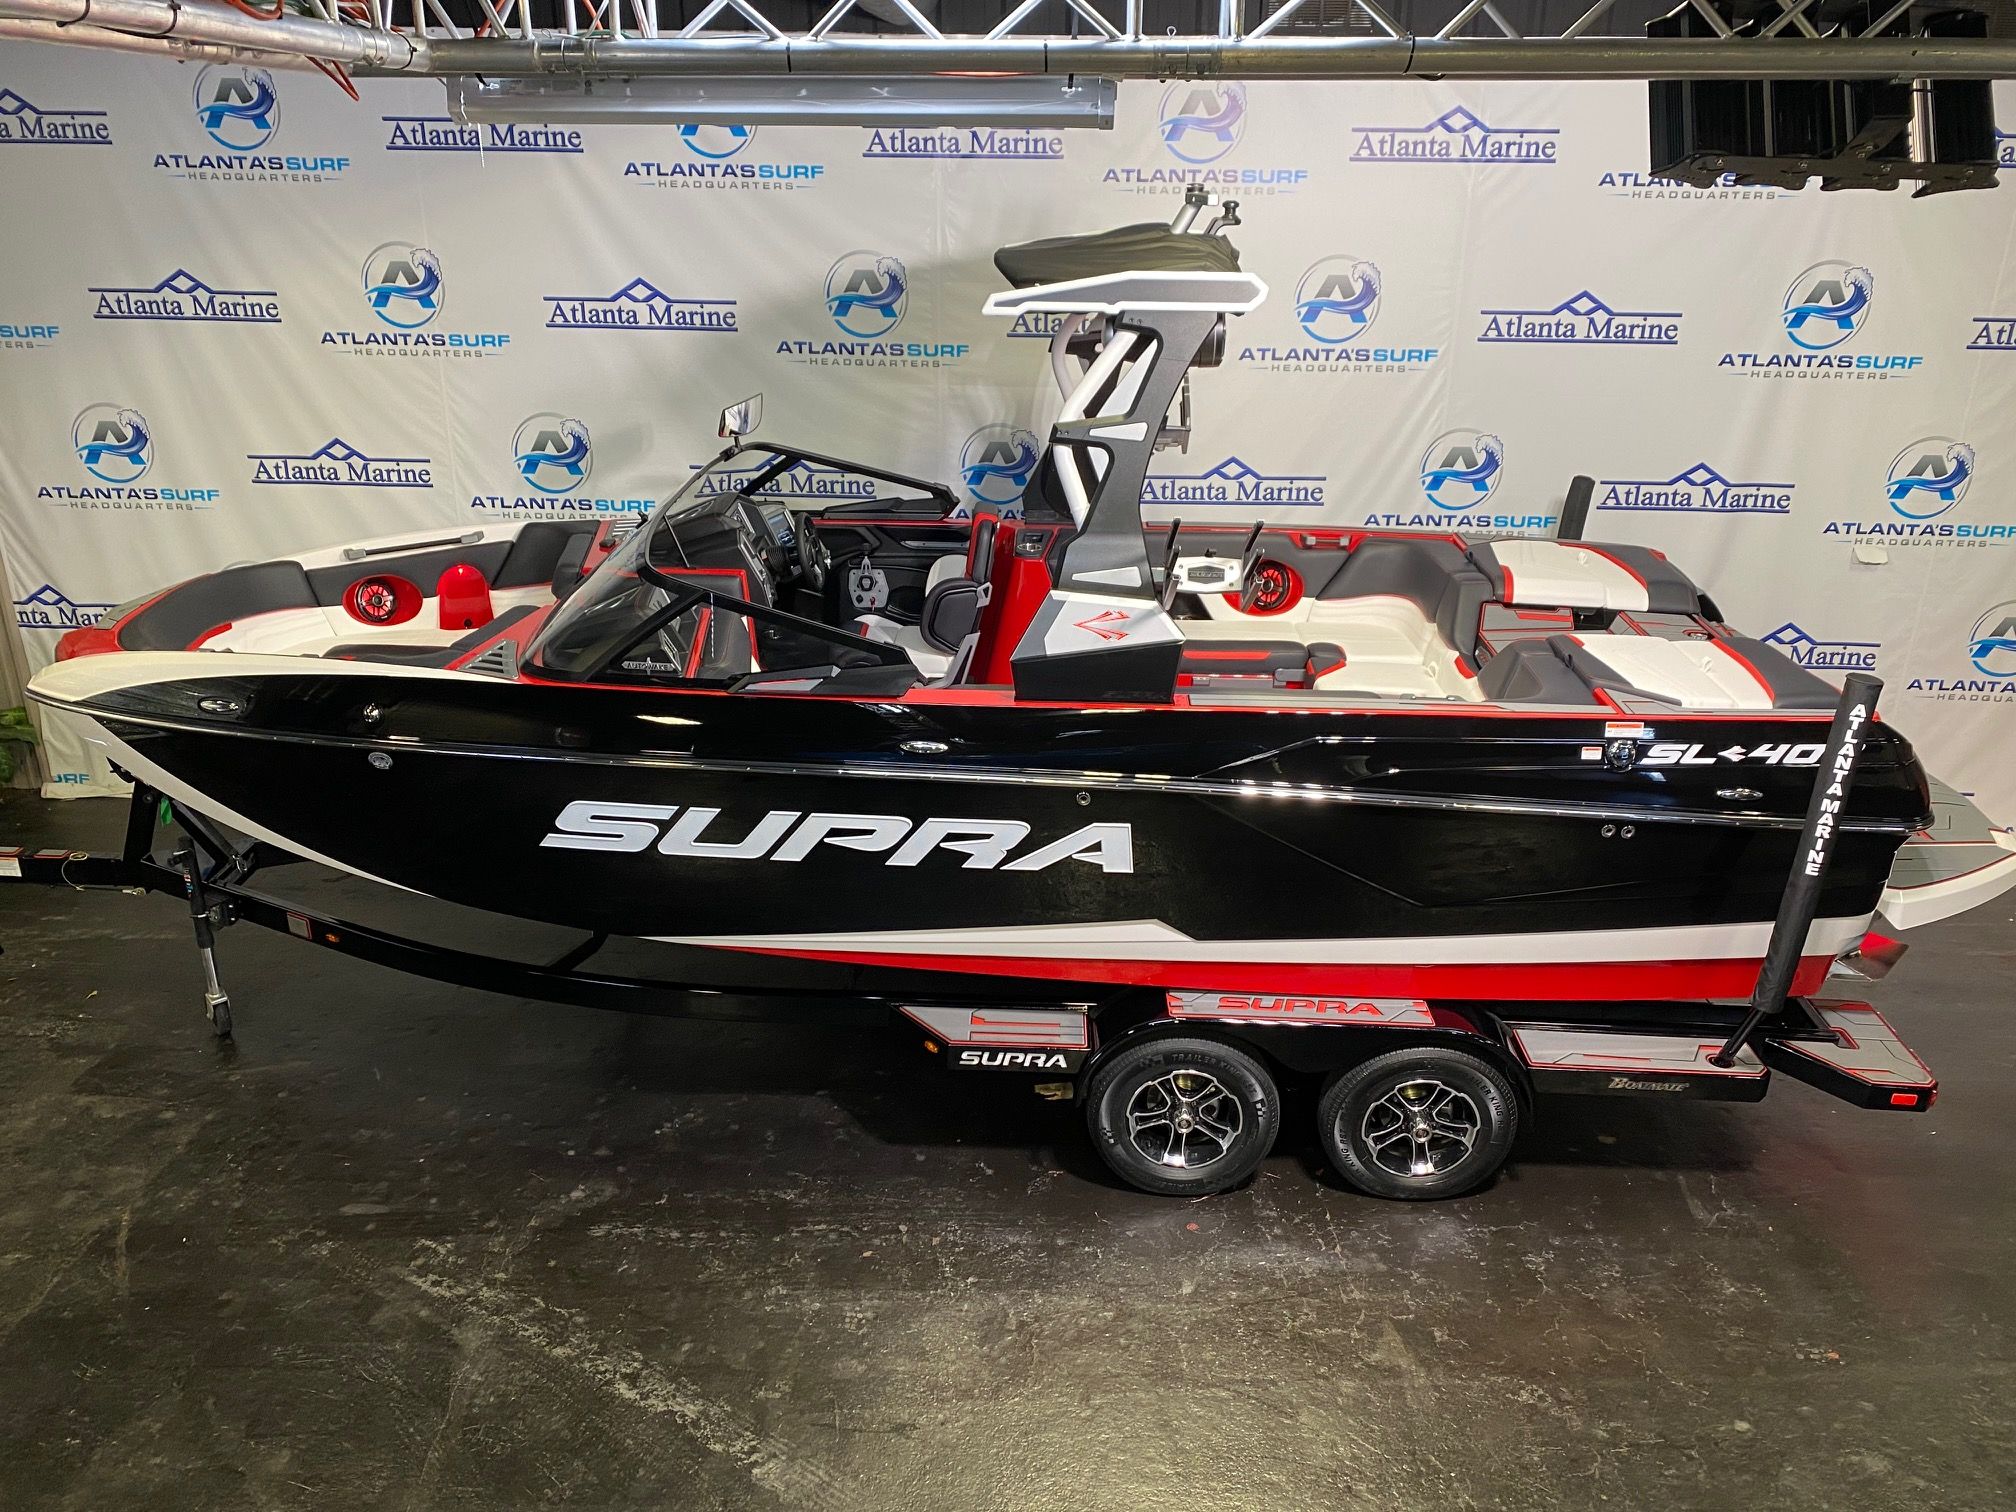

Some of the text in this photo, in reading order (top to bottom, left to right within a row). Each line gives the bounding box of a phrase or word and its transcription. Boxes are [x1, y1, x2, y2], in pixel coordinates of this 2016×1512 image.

[19, 114, 109, 140] Marine
[389, 121, 582, 149] Atlanta Marine
[866, 129, 1063, 155] Atlanta Marine
[1355, 132, 1556, 160] Atlanta Marine
[286, 156, 351, 172] SURF
[188, 171, 323, 183] HEADQUARTERS
[757, 164, 825, 180] SURF
[1241, 170, 1309, 184] SURF
[658, 180, 794, 190] HEADQUARTERS
[1136, 185, 1277, 196] HEADARTERS
[1631, 190, 1777, 201] HEADQUARTERS
[95, 292, 279, 319] Atlanta Marine
[549, 301, 736, 328] Atlanta Marine
[0, 325, 60, 338] SURF
[1481, 314, 1679, 341] Atlanta Marine
[447, 333, 511, 348] SURF
[353, 348, 484, 358] HEADQUARTERS
[906, 344, 970, 358] SURF
[1372, 348, 1439, 363] SURF
[808, 357, 941, 369] HEADQUARTERS
[1271, 364, 1407, 374] HEADQUARTERS
[1855, 356, 1923, 370] SURF
[1750, 370, 1889, 380] HEADQUARTERS
[254, 459, 432, 484] Atlanta Marine
[788, 473, 875, 495] Marine
[1141, 478, 1324, 502] Atlanta Marine
[160, 488, 220, 502] SURF
[1601, 485, 1791, 510] Atlanta Marine
[70, 502, 193, 511] HEADQUARTERS
[1493, 515, 1558, 528] SURF
[1854, 538, 1988, 548] HEADQUARTERS
[1790, 645, 1876, 667] Marine
[1805, 703, 1868, 877] ATLANTA MARINE
[539, 800, 1134, 874] SUPRA
[1217, 996, 1385, 1017] SUPRA
[959, 1051, 1069, 1069] SUPRA
